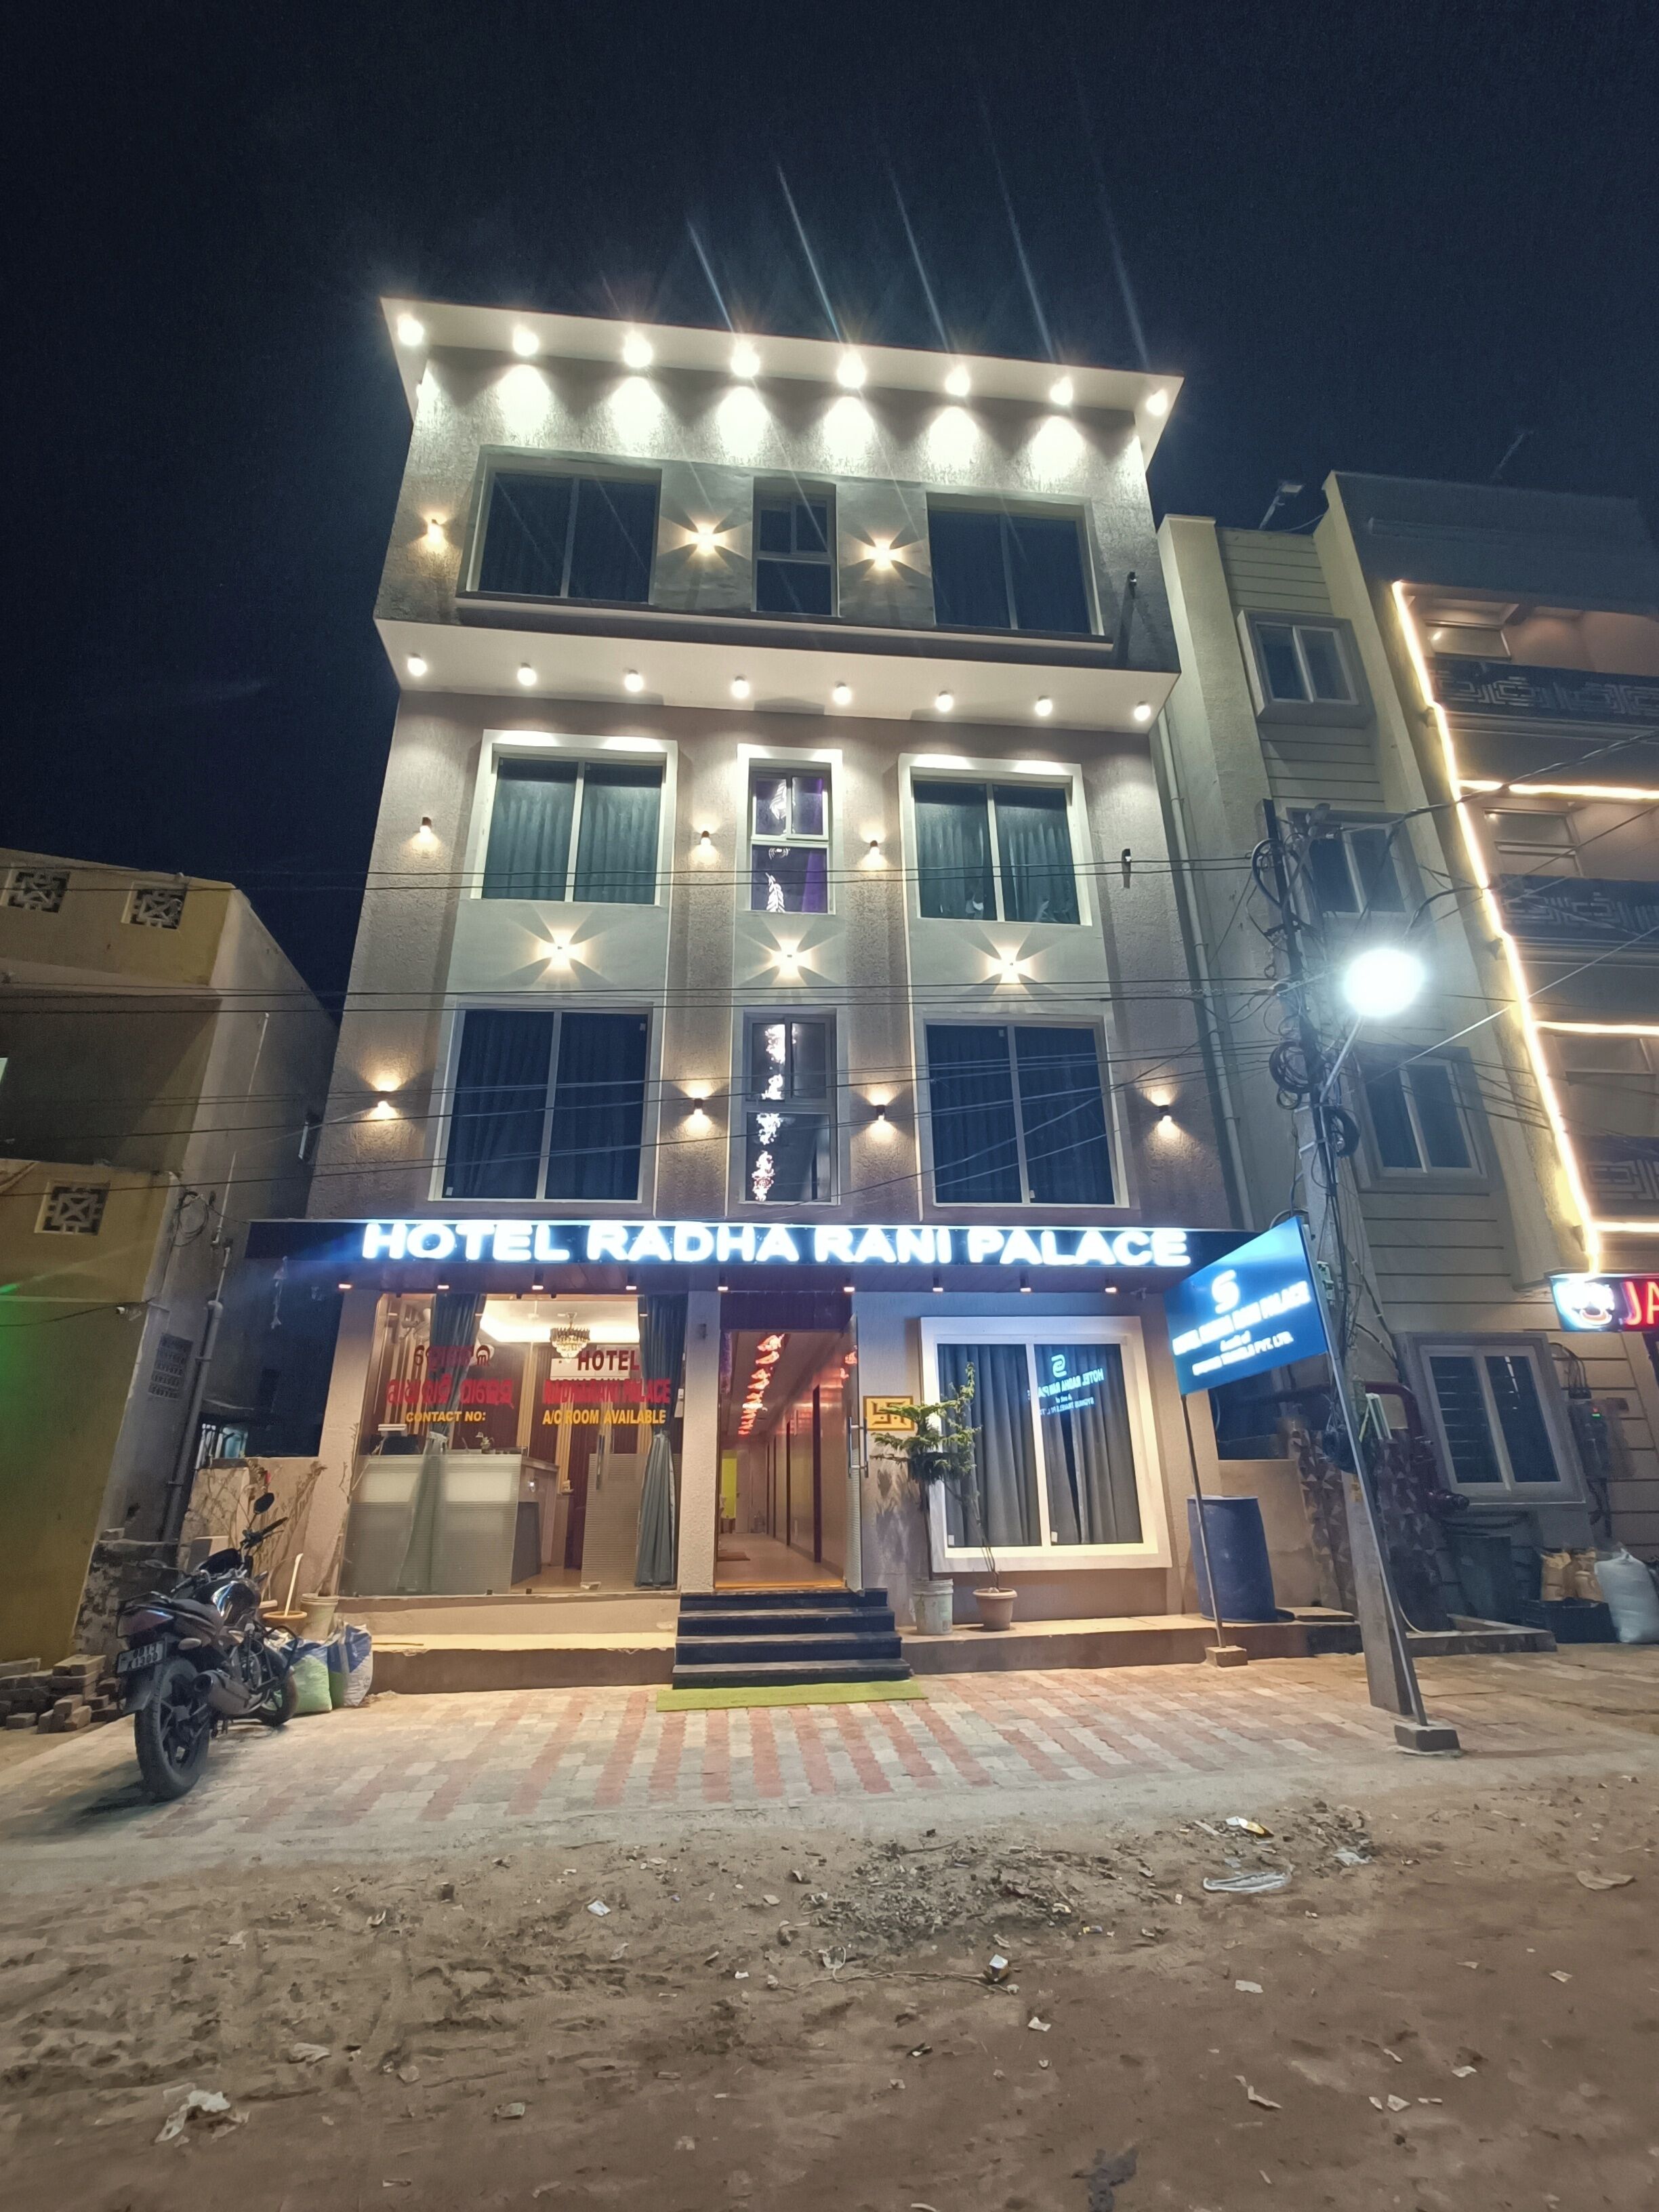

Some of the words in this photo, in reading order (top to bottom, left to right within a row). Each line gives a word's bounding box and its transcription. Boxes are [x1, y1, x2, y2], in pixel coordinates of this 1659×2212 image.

[363, 1223, 570, 1261] HOTEL
[587, 1223, 800, 1263] RADHA
[815, 1226, 952, 1263] RANI
[967, 1228, 1191, 1266] PALACE
[577, 1350, 640, 1371] HOTEL
[407, 1411, 462, 1422] CONTACT
[465, 1411, 486, 1422] NO:
[543, 1410, 562, 1425] A/C
[565, 1410, 599, 1424] ROOM
[603, 1409, 666, 1424] AVAILABLE
